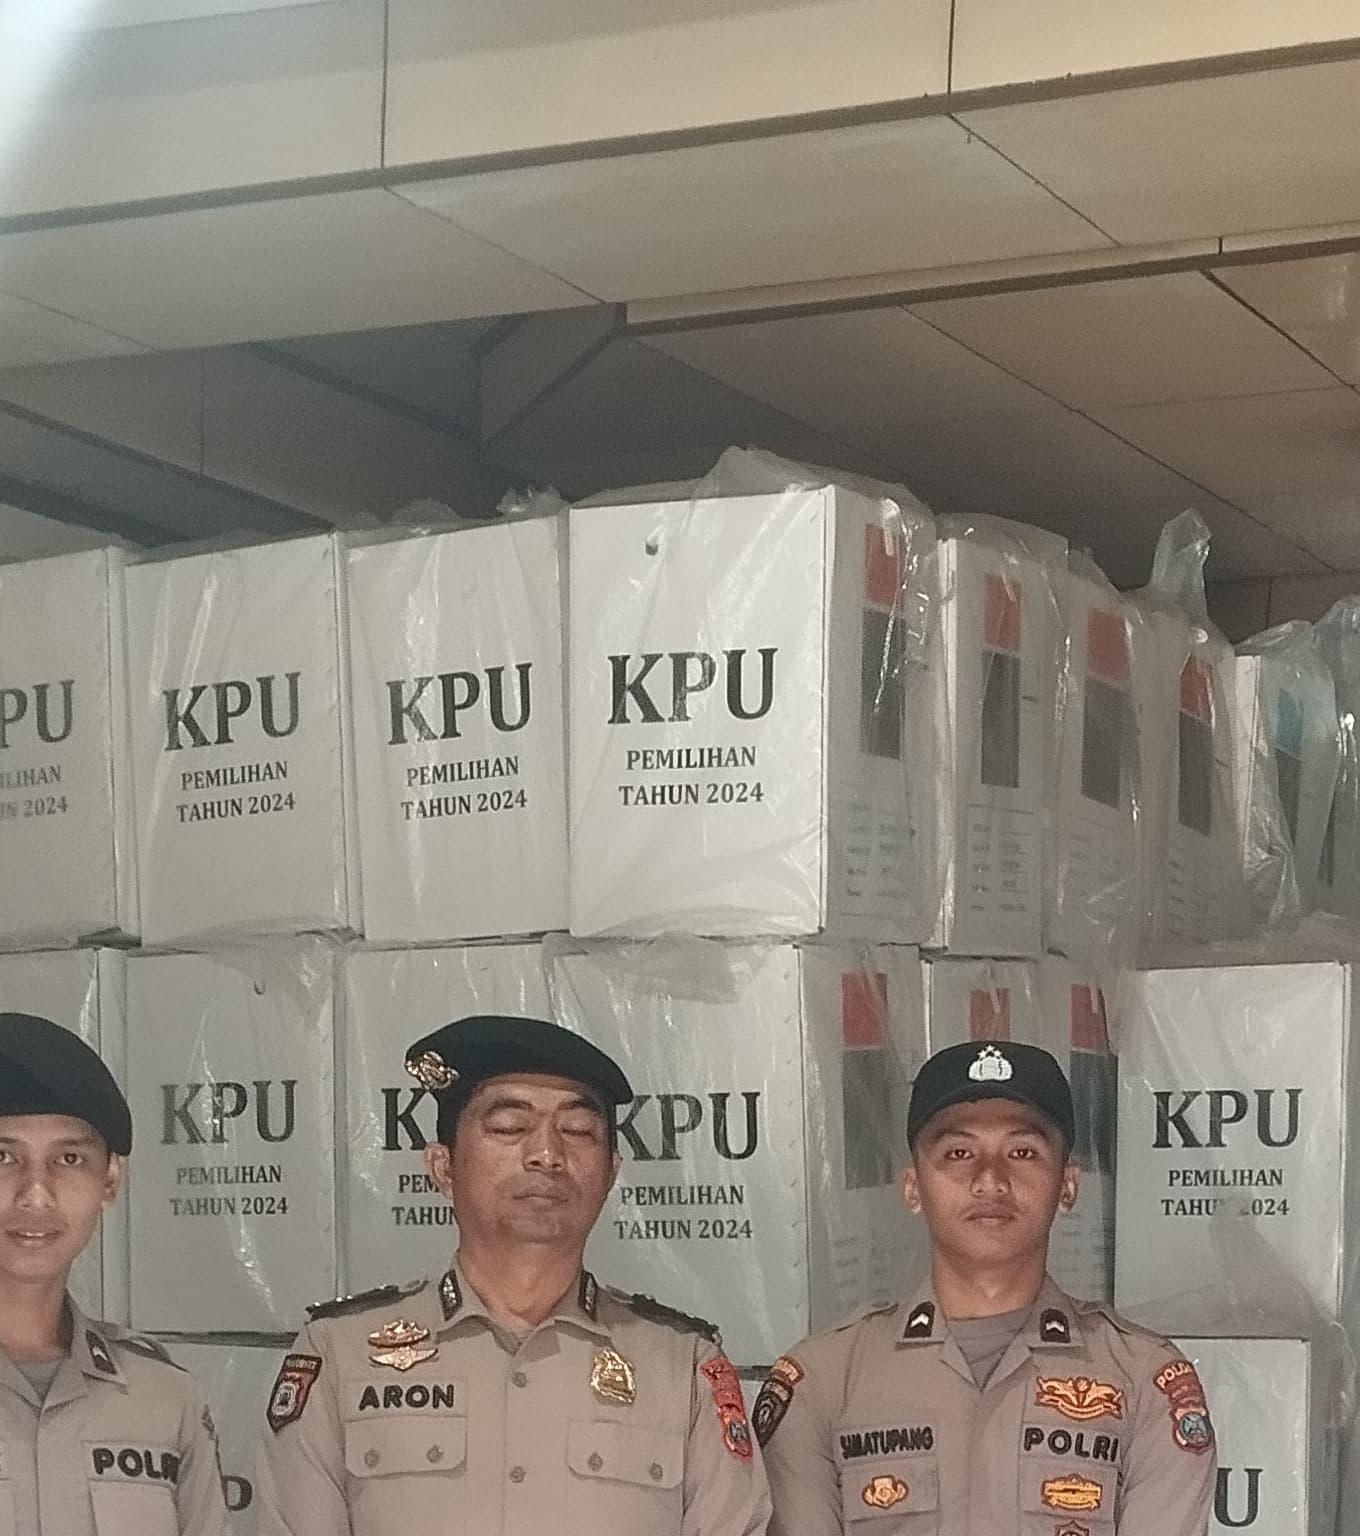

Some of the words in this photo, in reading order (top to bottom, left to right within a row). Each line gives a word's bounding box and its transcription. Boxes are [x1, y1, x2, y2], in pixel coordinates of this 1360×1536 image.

[607, 648, 778, 724] KPU
[162, 672, 301, 751] KPU
[385, 662, 533, 745] KPU
[406, 756, 519, 787] PEMILIHAN
[626, 746, 756, 770] PEMILIHAN
[181, 761, 288, 791] PEMILIHAN
[24, 795, 68, 817] 2024
[176, 798, 243, 823] TAHUN
[249, 791, 296, 814] 2024
[400, 794, 471, 820] TAHUN
[477, 789, 528, 812] 2024
[618, 784, 699, 806] TAHUN
[706, 782, 764, 804] 2024
[160, 1080, 298, 1145] KPU
[616, 1092, 761, 1161] KPU
[1152, 1088, 1304, 1148] KPU
[176, 1165, 282, 1185] PEMILIHAN
[1168, 1168, 1283, 1188] PEMILIHAN
[169, 1197, 236, 1217] TAHUN
[240, 1196, 289, 1215] 2024
[620, 1184, 745, 1206] PEMILIHAN
[1161, 1198, 1222, 1217] TAHU
[614, 1220, 691, 1240] TAHUN
[698, 1219, 753, 1240] 2024
[358, 1383, 455, 1412] ARON
[1023, 1427, 1120, 1463] POLRI
